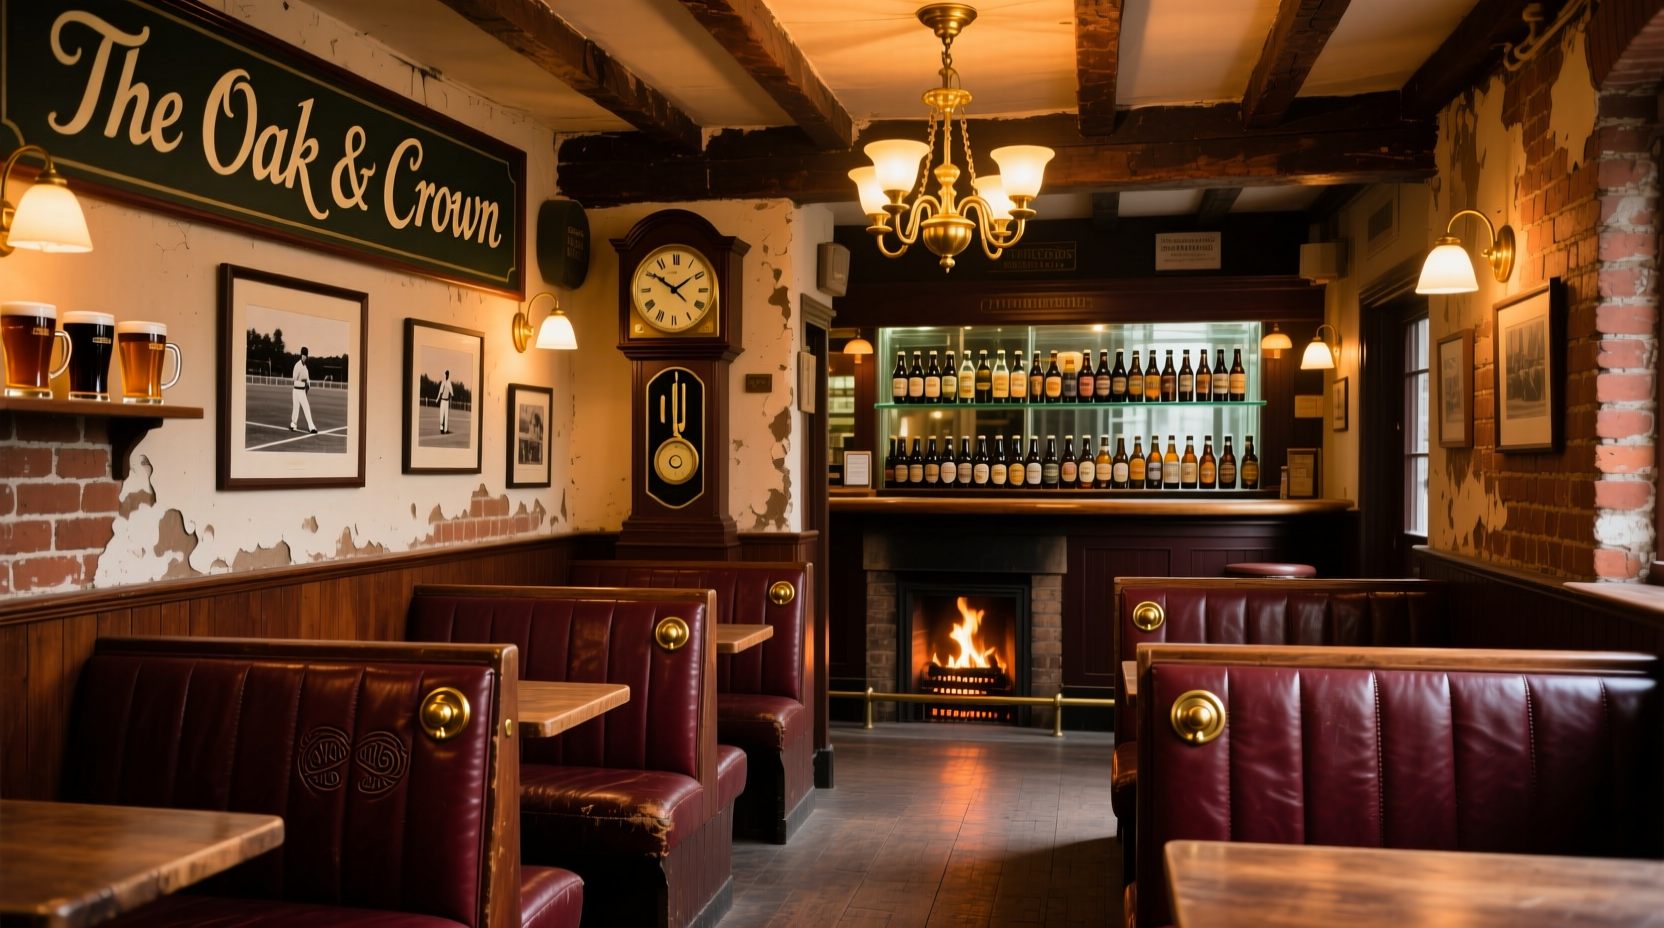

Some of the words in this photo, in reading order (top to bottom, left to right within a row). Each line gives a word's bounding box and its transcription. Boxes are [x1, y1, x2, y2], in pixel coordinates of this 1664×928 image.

[48, 11, 183, 153] The
[202, 68, 329, 220] Oak
[331, 125, 376, 211] &
[383, 138, 502, 249] Crown
